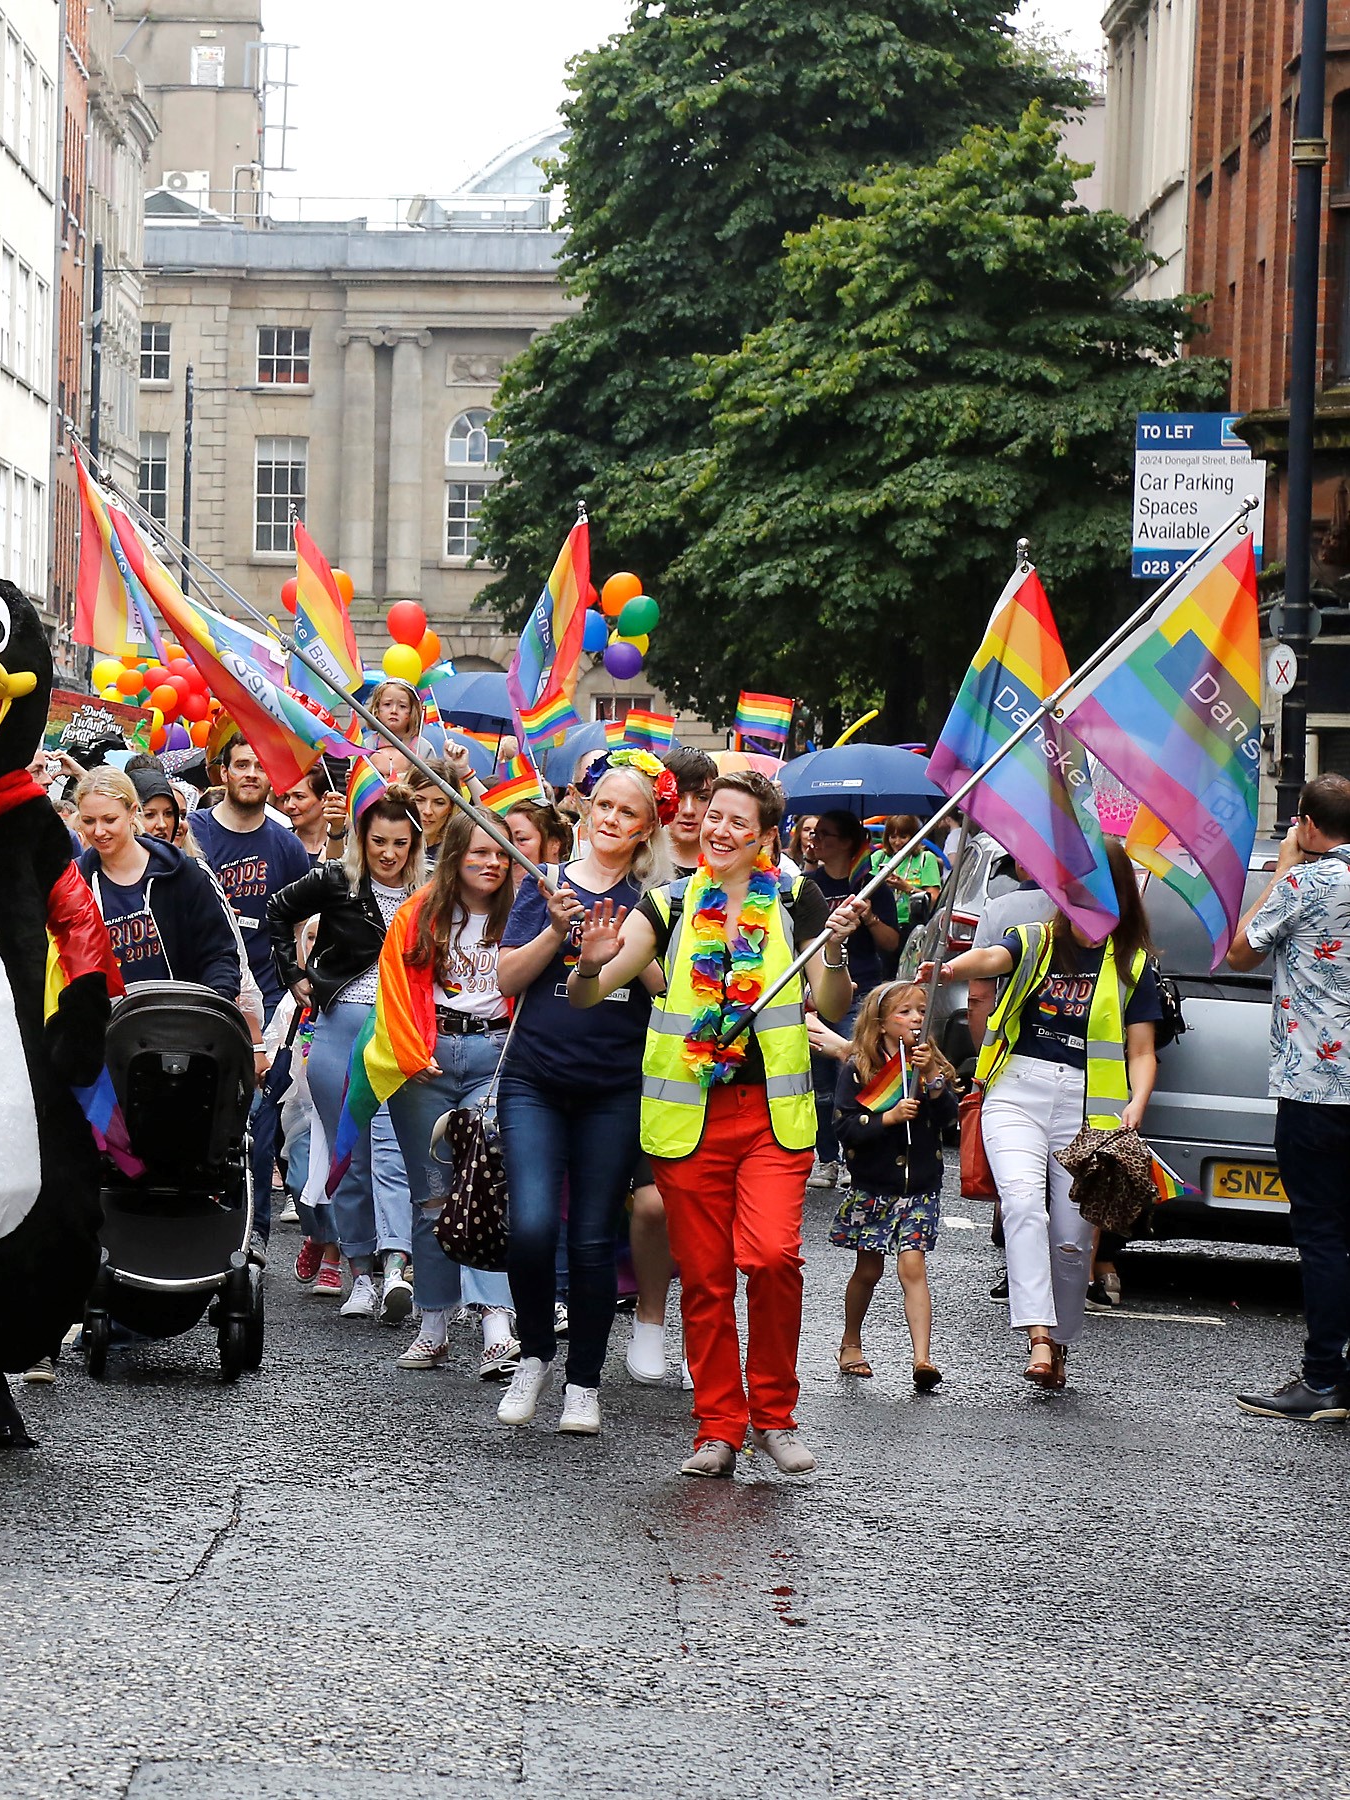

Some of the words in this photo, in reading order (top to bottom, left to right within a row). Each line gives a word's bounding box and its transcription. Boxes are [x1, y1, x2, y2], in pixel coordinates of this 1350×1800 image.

[1141, 425, 1161, 439] TO
[1166, 425, 1194, 439] LET
[1140, 456, 1162, 465] 20/24
[1165, 456, 1200, 467] Donegall
[1140, 473, 1169, 491] Car
[1174, 473, 1234, 495] Parking
[1139, 497, 1198, 519] Spaces
[1138, 522, 1210, 540] Available
[1141, 561, 1169, 575] 028
[78, 718, 106, 734] want
[994, 685, 1087, 787] Danske
[234, 883, 267, 898] 2019
[239, 918, 257, 927] Bank
[108, 916, 159, 951] RIDE
[125, 941, 161, 963] 2019
